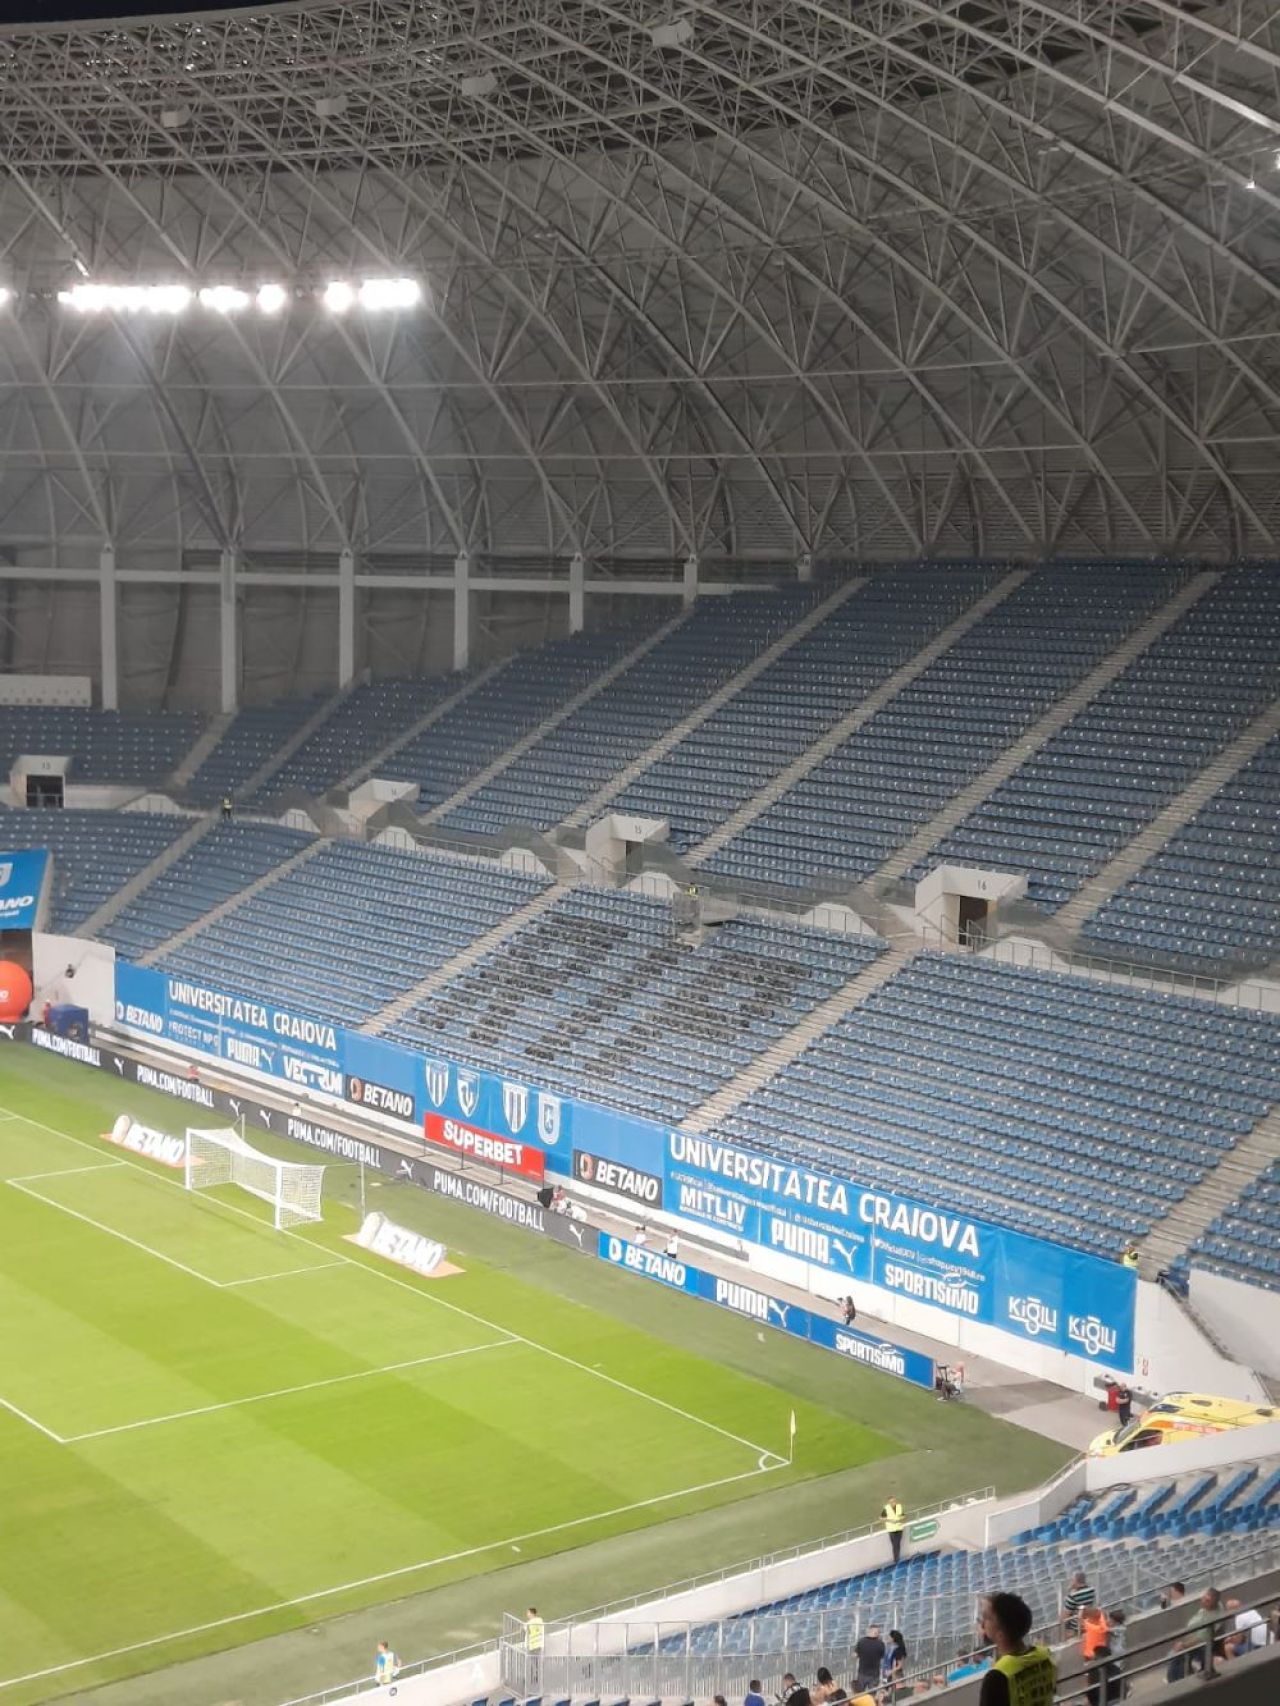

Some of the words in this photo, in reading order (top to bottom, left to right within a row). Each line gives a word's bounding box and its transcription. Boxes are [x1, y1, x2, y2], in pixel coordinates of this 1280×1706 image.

[126, 1004, 163, 1034] BETANO
[168, 979, 269, 1030] UNIVERSITATEA
[273, 1011, 337, 1052] CRAIOVA
[227, 1037, 260, 1068] PUMA
[137, 1064, 215, 1108] PUMA.COM/FOOTBALL
[364, 1082, 413, 1117] BETANO
[287, 1118, 382, 1168] PUMA.COM/FOOTBALL
[443, 1120, 523, 1165] SUPERBET
[433, 1171, 545, 1232] PUMA.COM/FOOTBALL
[596, 1159, 659, 1202] BETANO
[670, 1133, 849, 1216] UNIVERSITATEA
[859, 1193, 979, 1258] CRAIOVA
[681, 1184, 747, 1226] MITLIV
[772, 1216, 829, 1264] PUMA
[625, 1246, 686, 1287] BETANO
[716, 1279, 769, 1320] PUMA
[885, 1263, 979, 1315] SPORTISIMO
